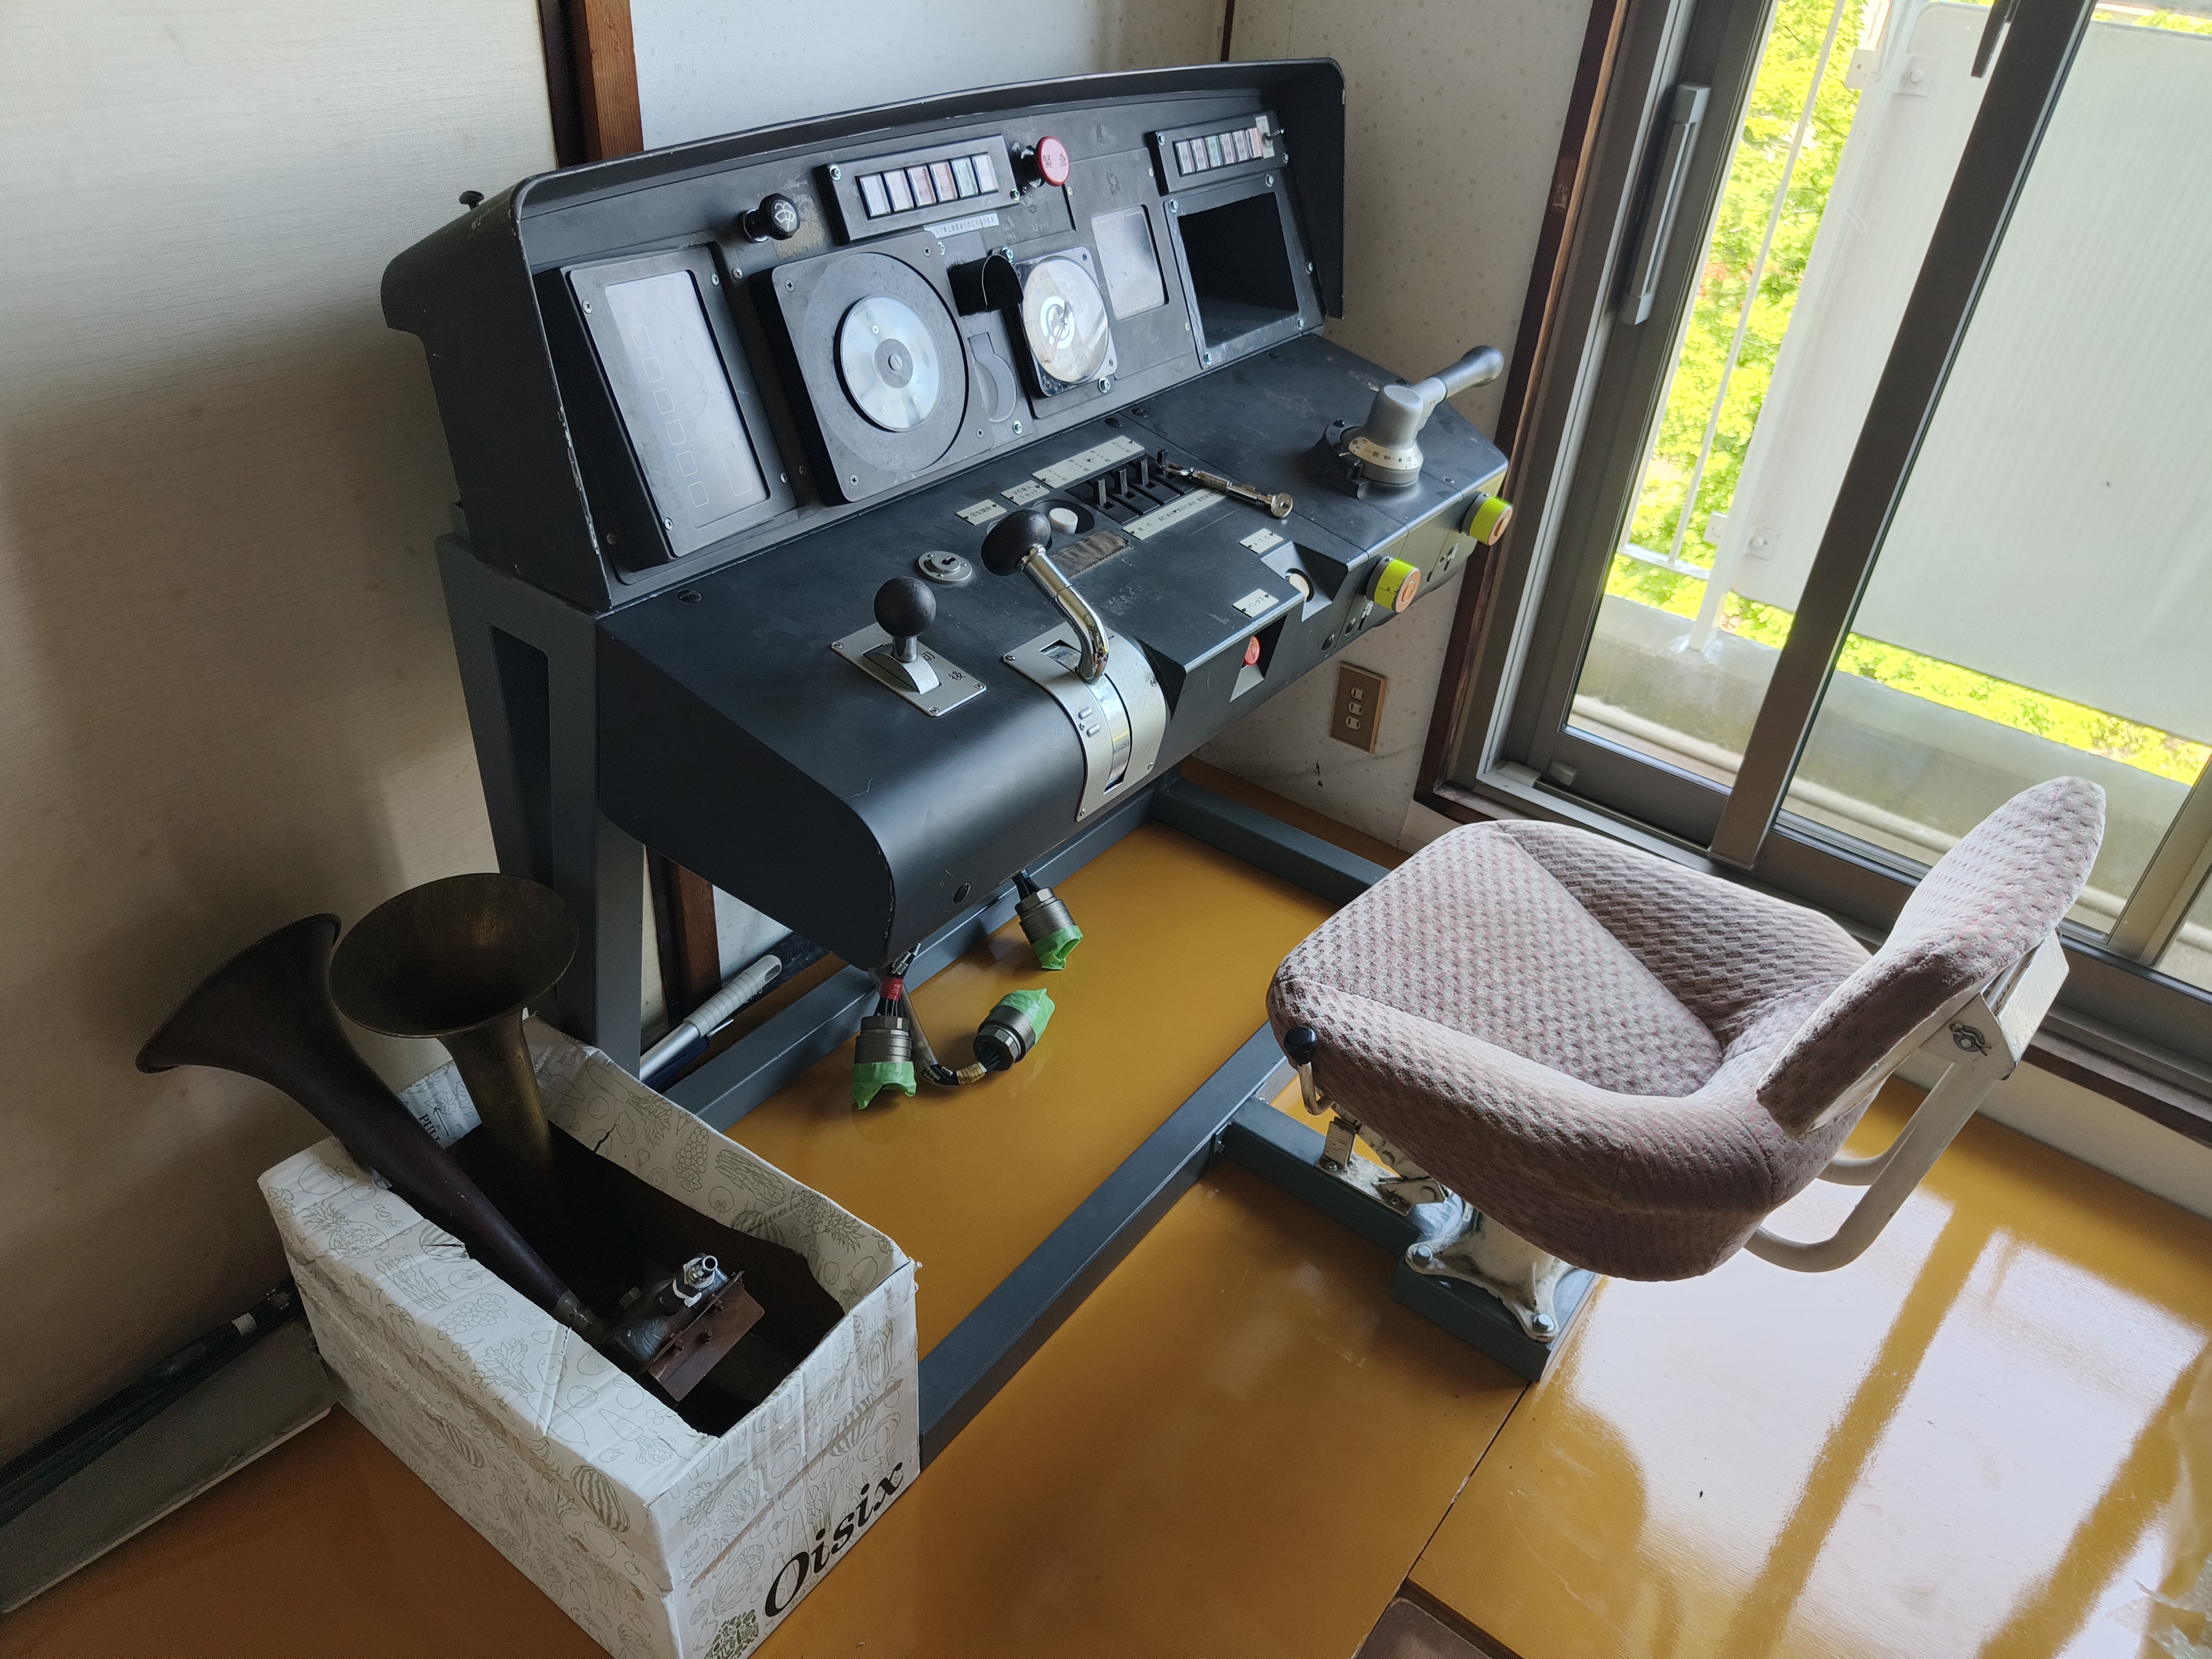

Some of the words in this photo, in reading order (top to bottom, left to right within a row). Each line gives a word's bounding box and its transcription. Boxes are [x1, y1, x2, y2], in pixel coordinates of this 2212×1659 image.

[866, 310, 874, 321] 60
[1253, 535, 1270, 546] ATC
[948, 671, 966, 681] 後
[764, 1461, 903, 1618] Oisix
